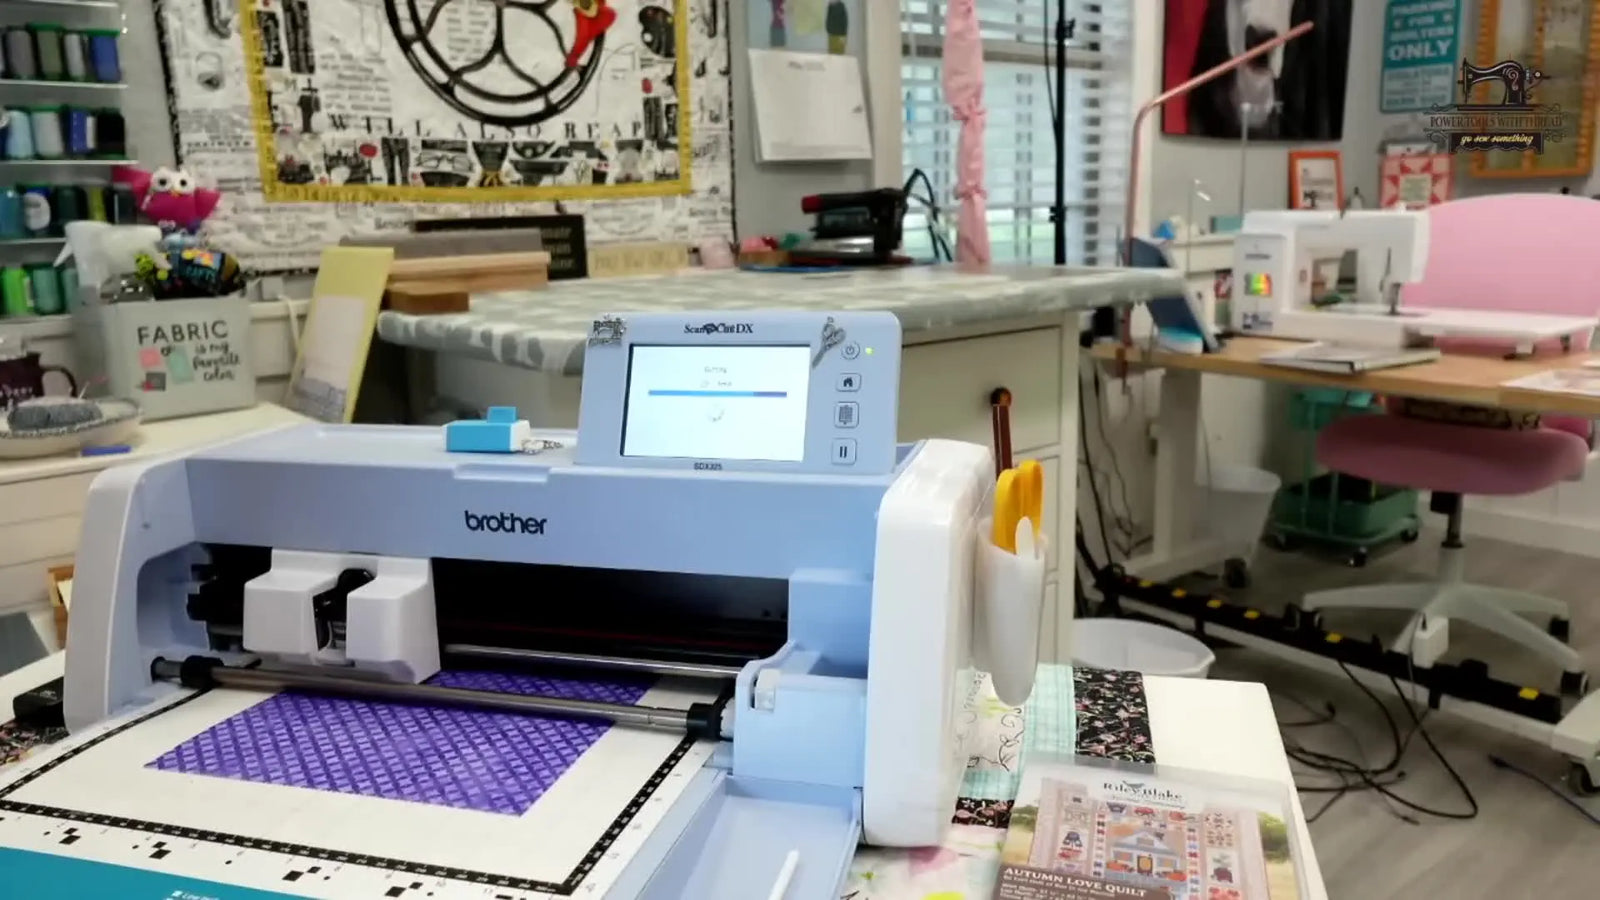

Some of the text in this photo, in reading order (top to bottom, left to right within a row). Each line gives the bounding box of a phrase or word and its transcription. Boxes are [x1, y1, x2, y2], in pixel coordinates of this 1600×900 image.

[1388, 39, 1452, 61] ONLY
[455, 122, 542, 141] ALSO
[564, 120, 642, 140] REAP
[137, 320, 229, 345] FABRIC
[209, 341, 230, 355] my
[192, 352, 240, 371] favorite
[203, 366, 235, 382] color
[464, 509, 548, 535] brother
[1103, 782, 1183, 800] Riley Blake
[1003, 867, 1064, 883] AUTUMN
[1066, 877, 1103, 890] LOVE
[1105, 883, 1148, 897] QUILT
